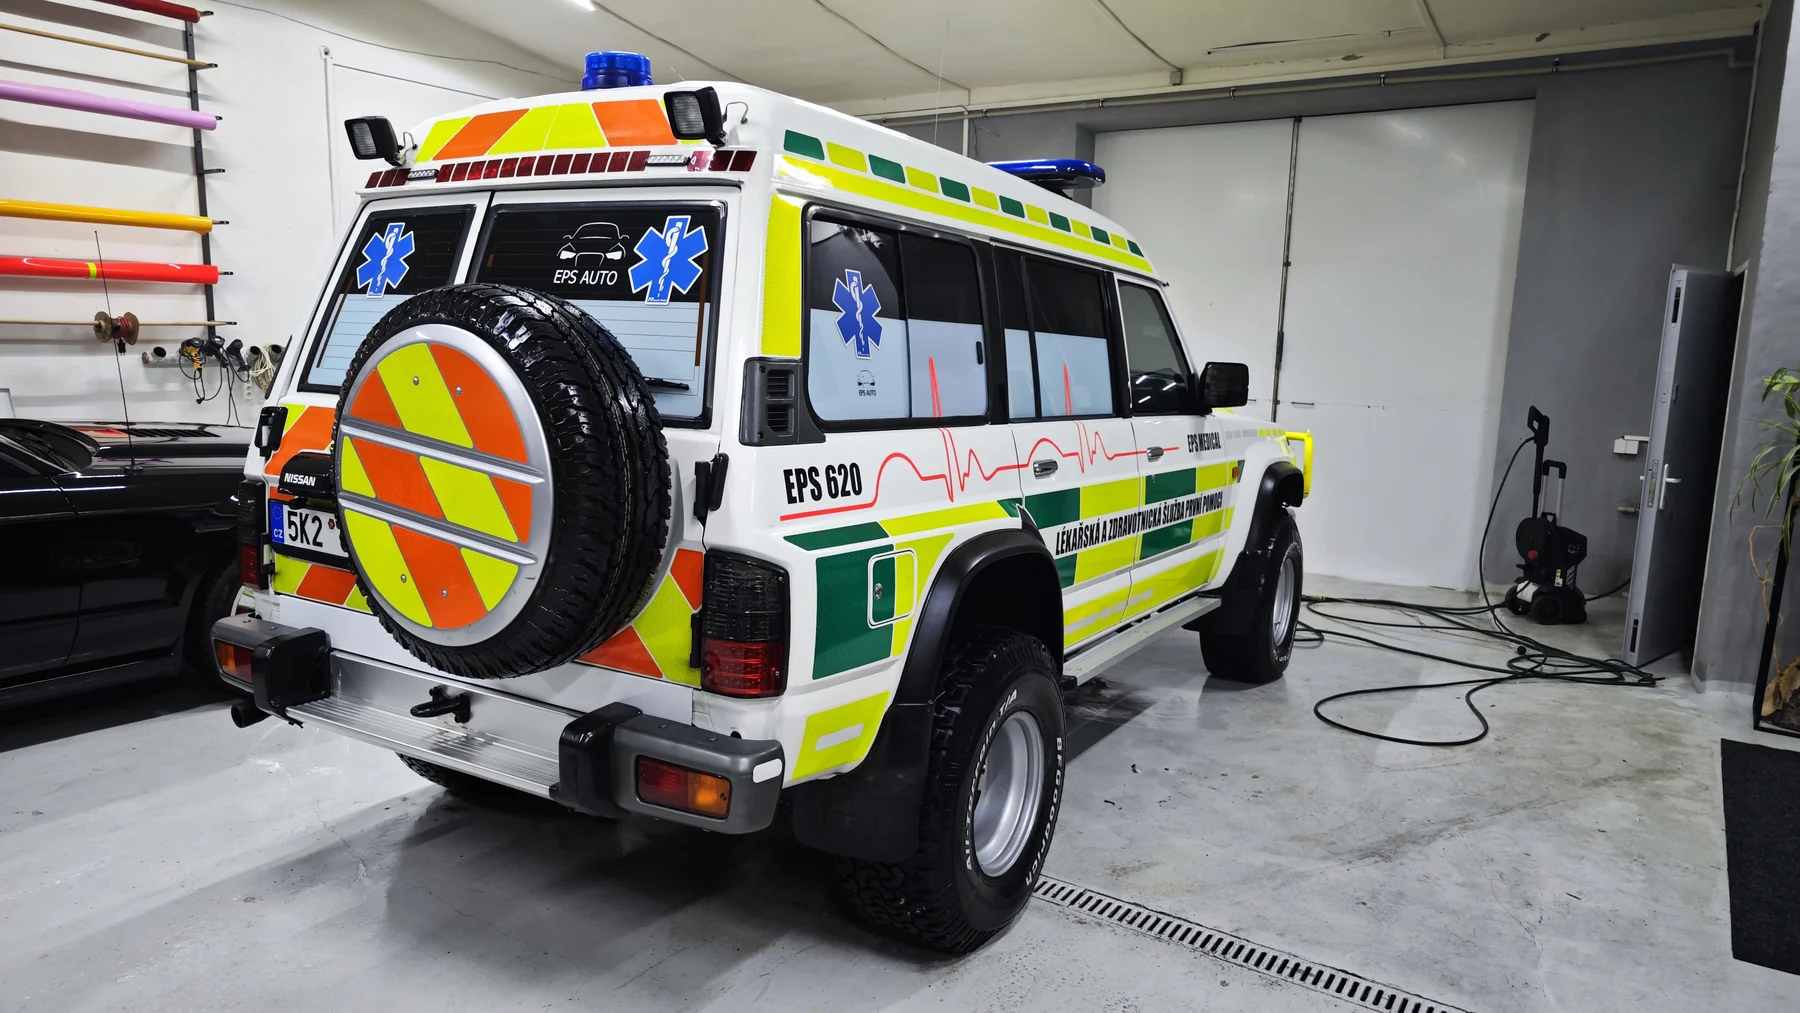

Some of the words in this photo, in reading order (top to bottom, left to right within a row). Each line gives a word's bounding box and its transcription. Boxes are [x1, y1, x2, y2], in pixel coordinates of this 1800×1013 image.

[553, 269, 578, 284] EPS
[579, 270, 618, 285] AUTO
[1187, 432, 1199, 453] EPS
[1199, 432, 1221, 451] MEDICAL
[284, 472, 316, 486] NISSAN
[783, 466, 822, 504] EPS
[825, 462, 862, 499] 620
[273, 528, 283, 538] CZ
[287, 510, 323, 547] 5K2
[1055, 518, 1100, 556] LÉKAŘSKÁ
[1101, 520, 1107, 543] A
[1108, 503, 1162, 540] ZDRAVOTNICKÁ
[999, 688, 1017, 716] T/A
